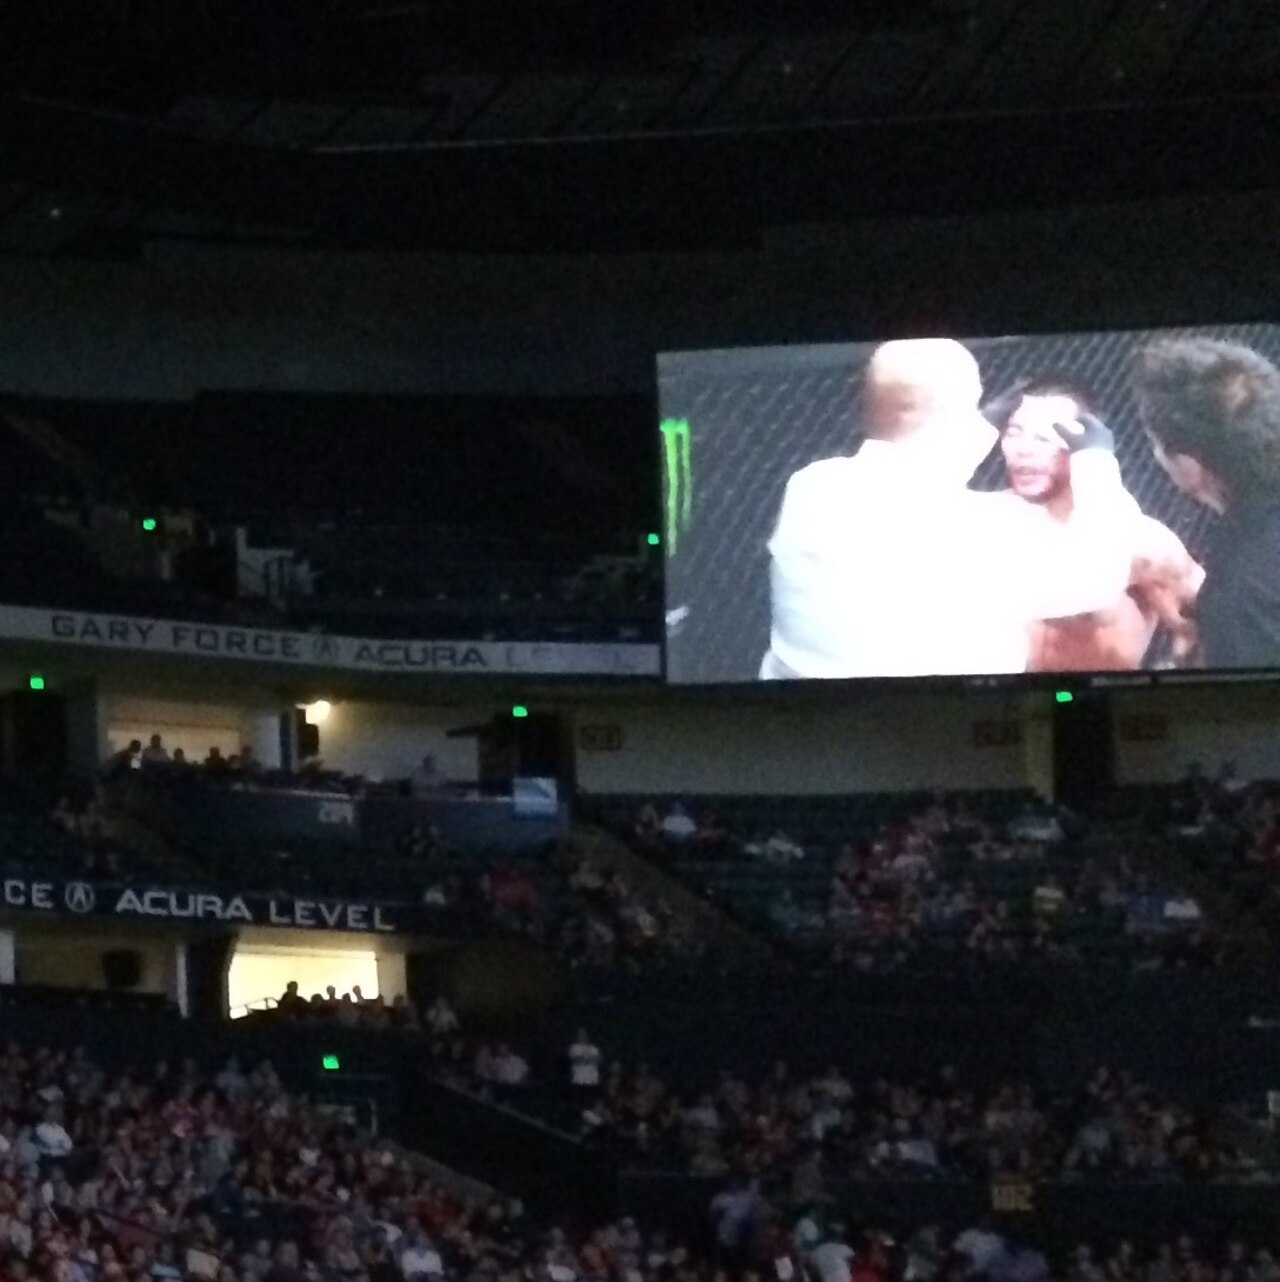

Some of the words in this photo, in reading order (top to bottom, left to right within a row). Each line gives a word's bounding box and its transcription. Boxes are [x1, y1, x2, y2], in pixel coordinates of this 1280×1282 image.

[51, 614, 154, 643] GARY
[172, 626, 300, 658] FORCE
[354, 644, 488, 666] ACURA
[115, 888, 254, 921] ACURA
[269, 899, 396, 931] LEVEL
